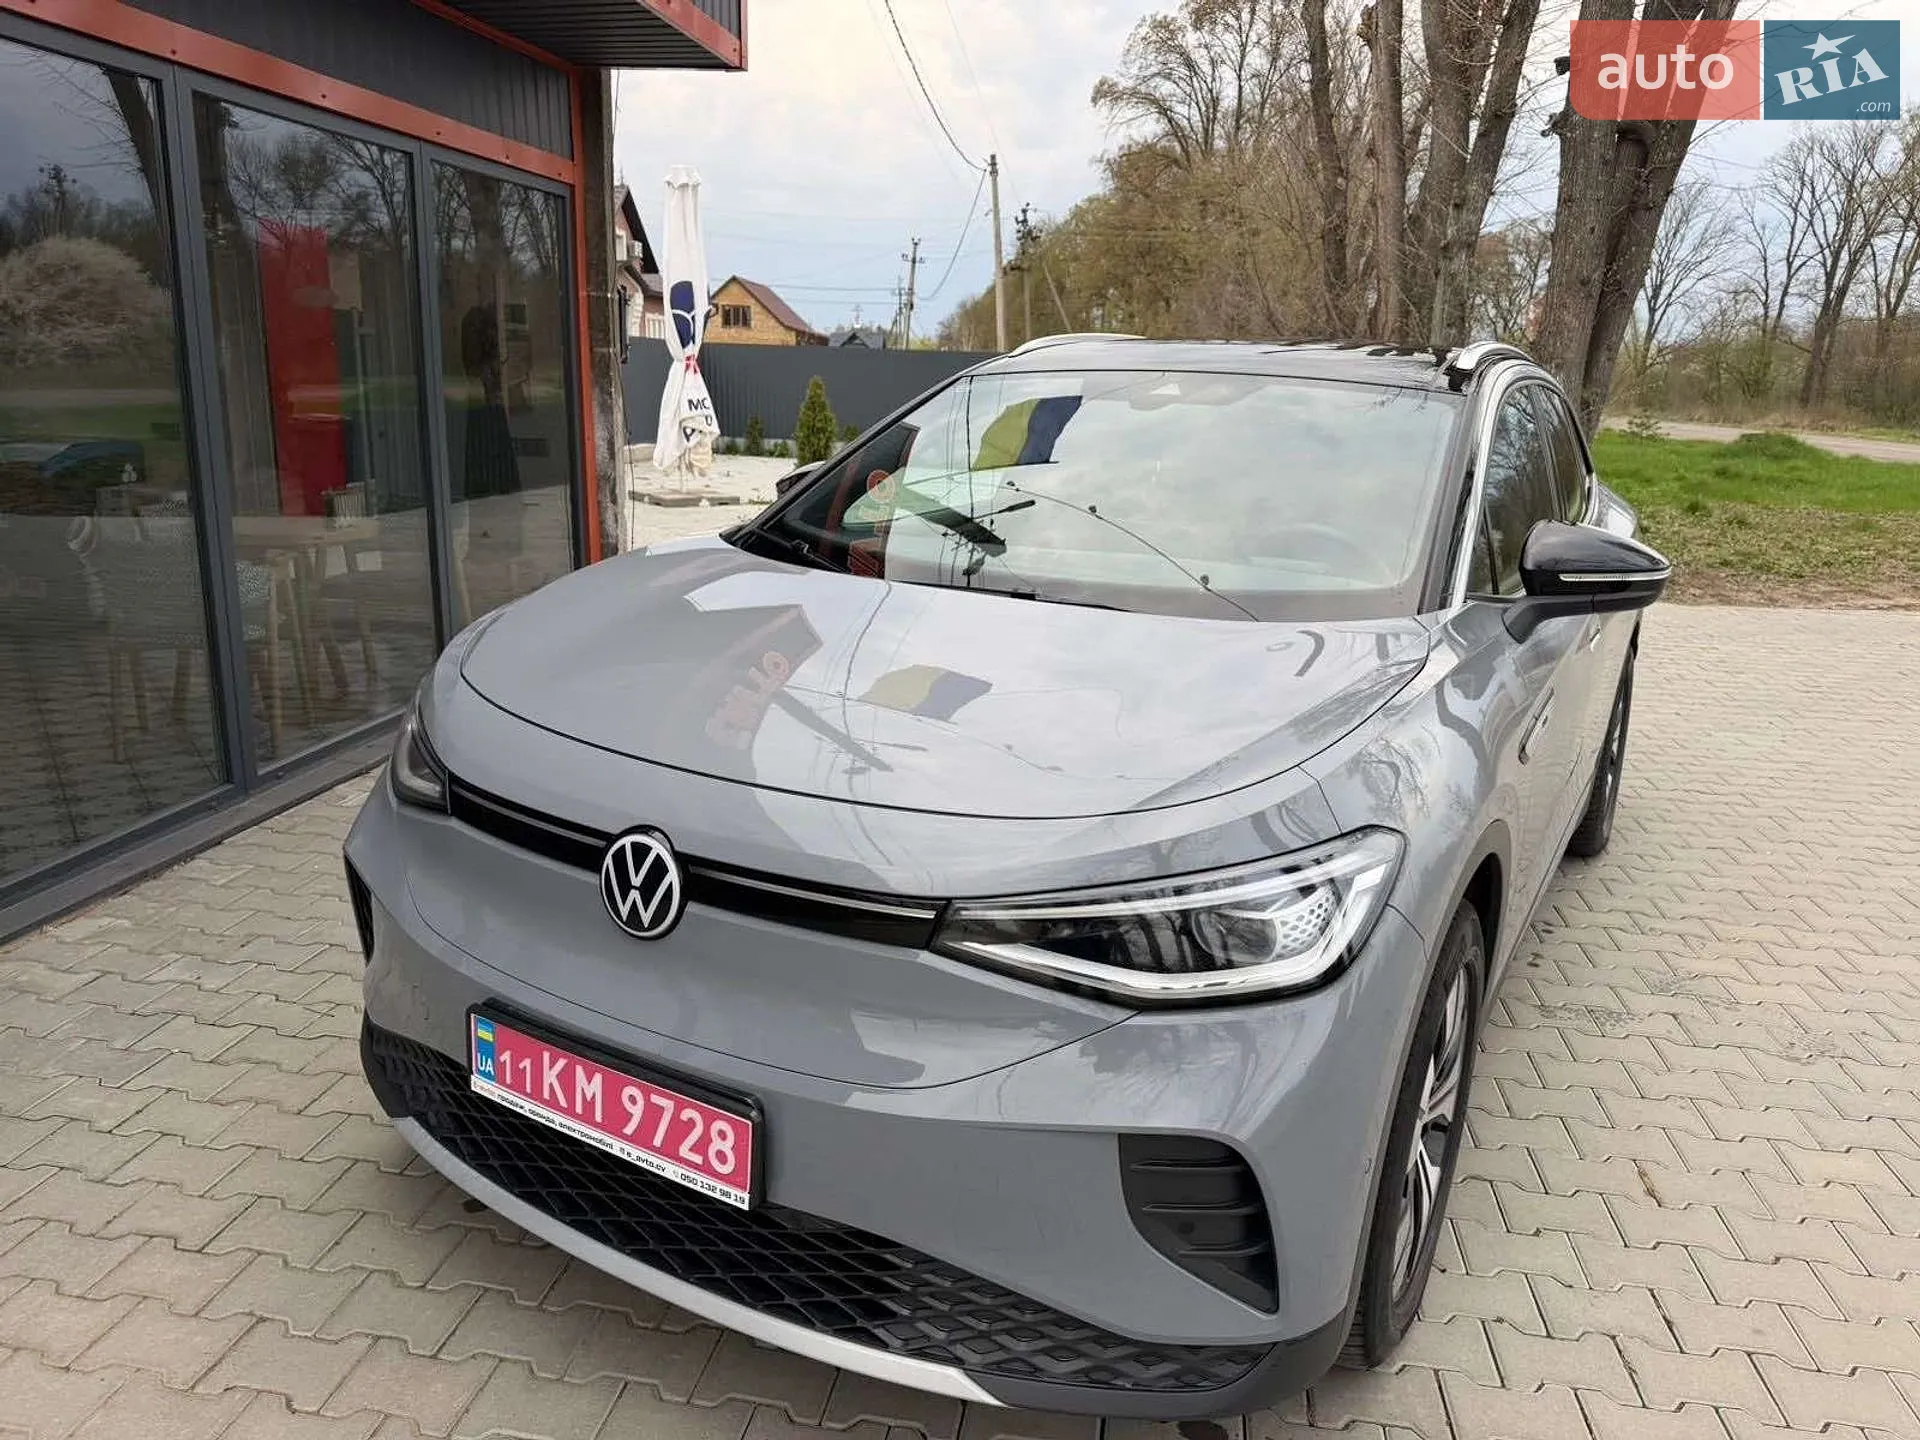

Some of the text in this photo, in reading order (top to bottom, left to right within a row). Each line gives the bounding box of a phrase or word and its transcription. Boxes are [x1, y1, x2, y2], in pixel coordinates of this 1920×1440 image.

[478, 1055, 495, 1075] UA
[499, 1049, 737, 1176] 11KM 9728
